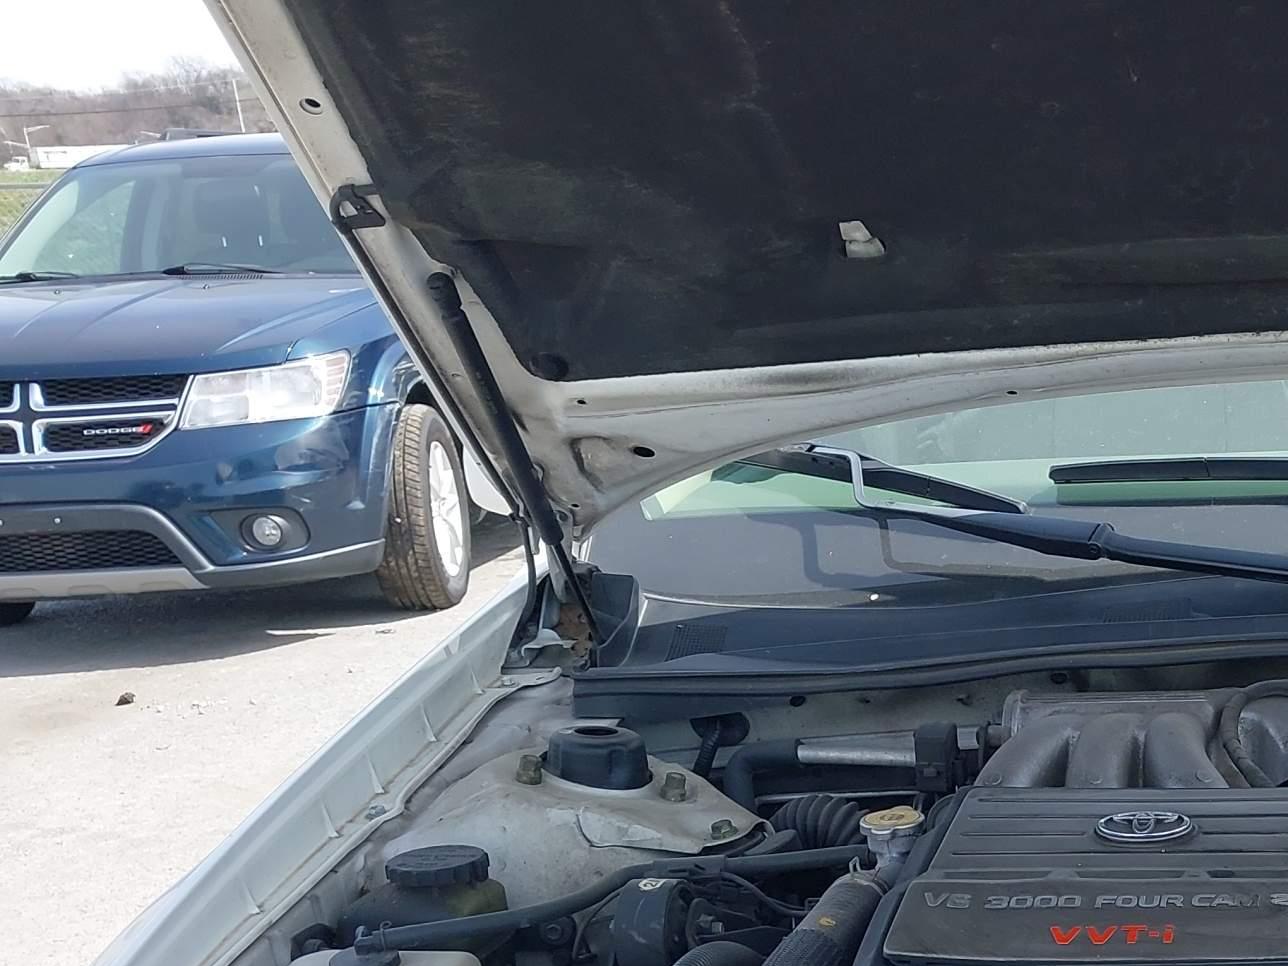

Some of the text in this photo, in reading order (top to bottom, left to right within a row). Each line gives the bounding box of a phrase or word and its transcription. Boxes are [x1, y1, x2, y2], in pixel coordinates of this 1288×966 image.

[83, 427, 143, 436] DODGE
[984, 893, 1081, 908] 3000
[1095, 894, 1184, 908] FOUR
[1191, 893, 1261, 909] CAM
[1050, 924, 1176, 945] VVT-i
